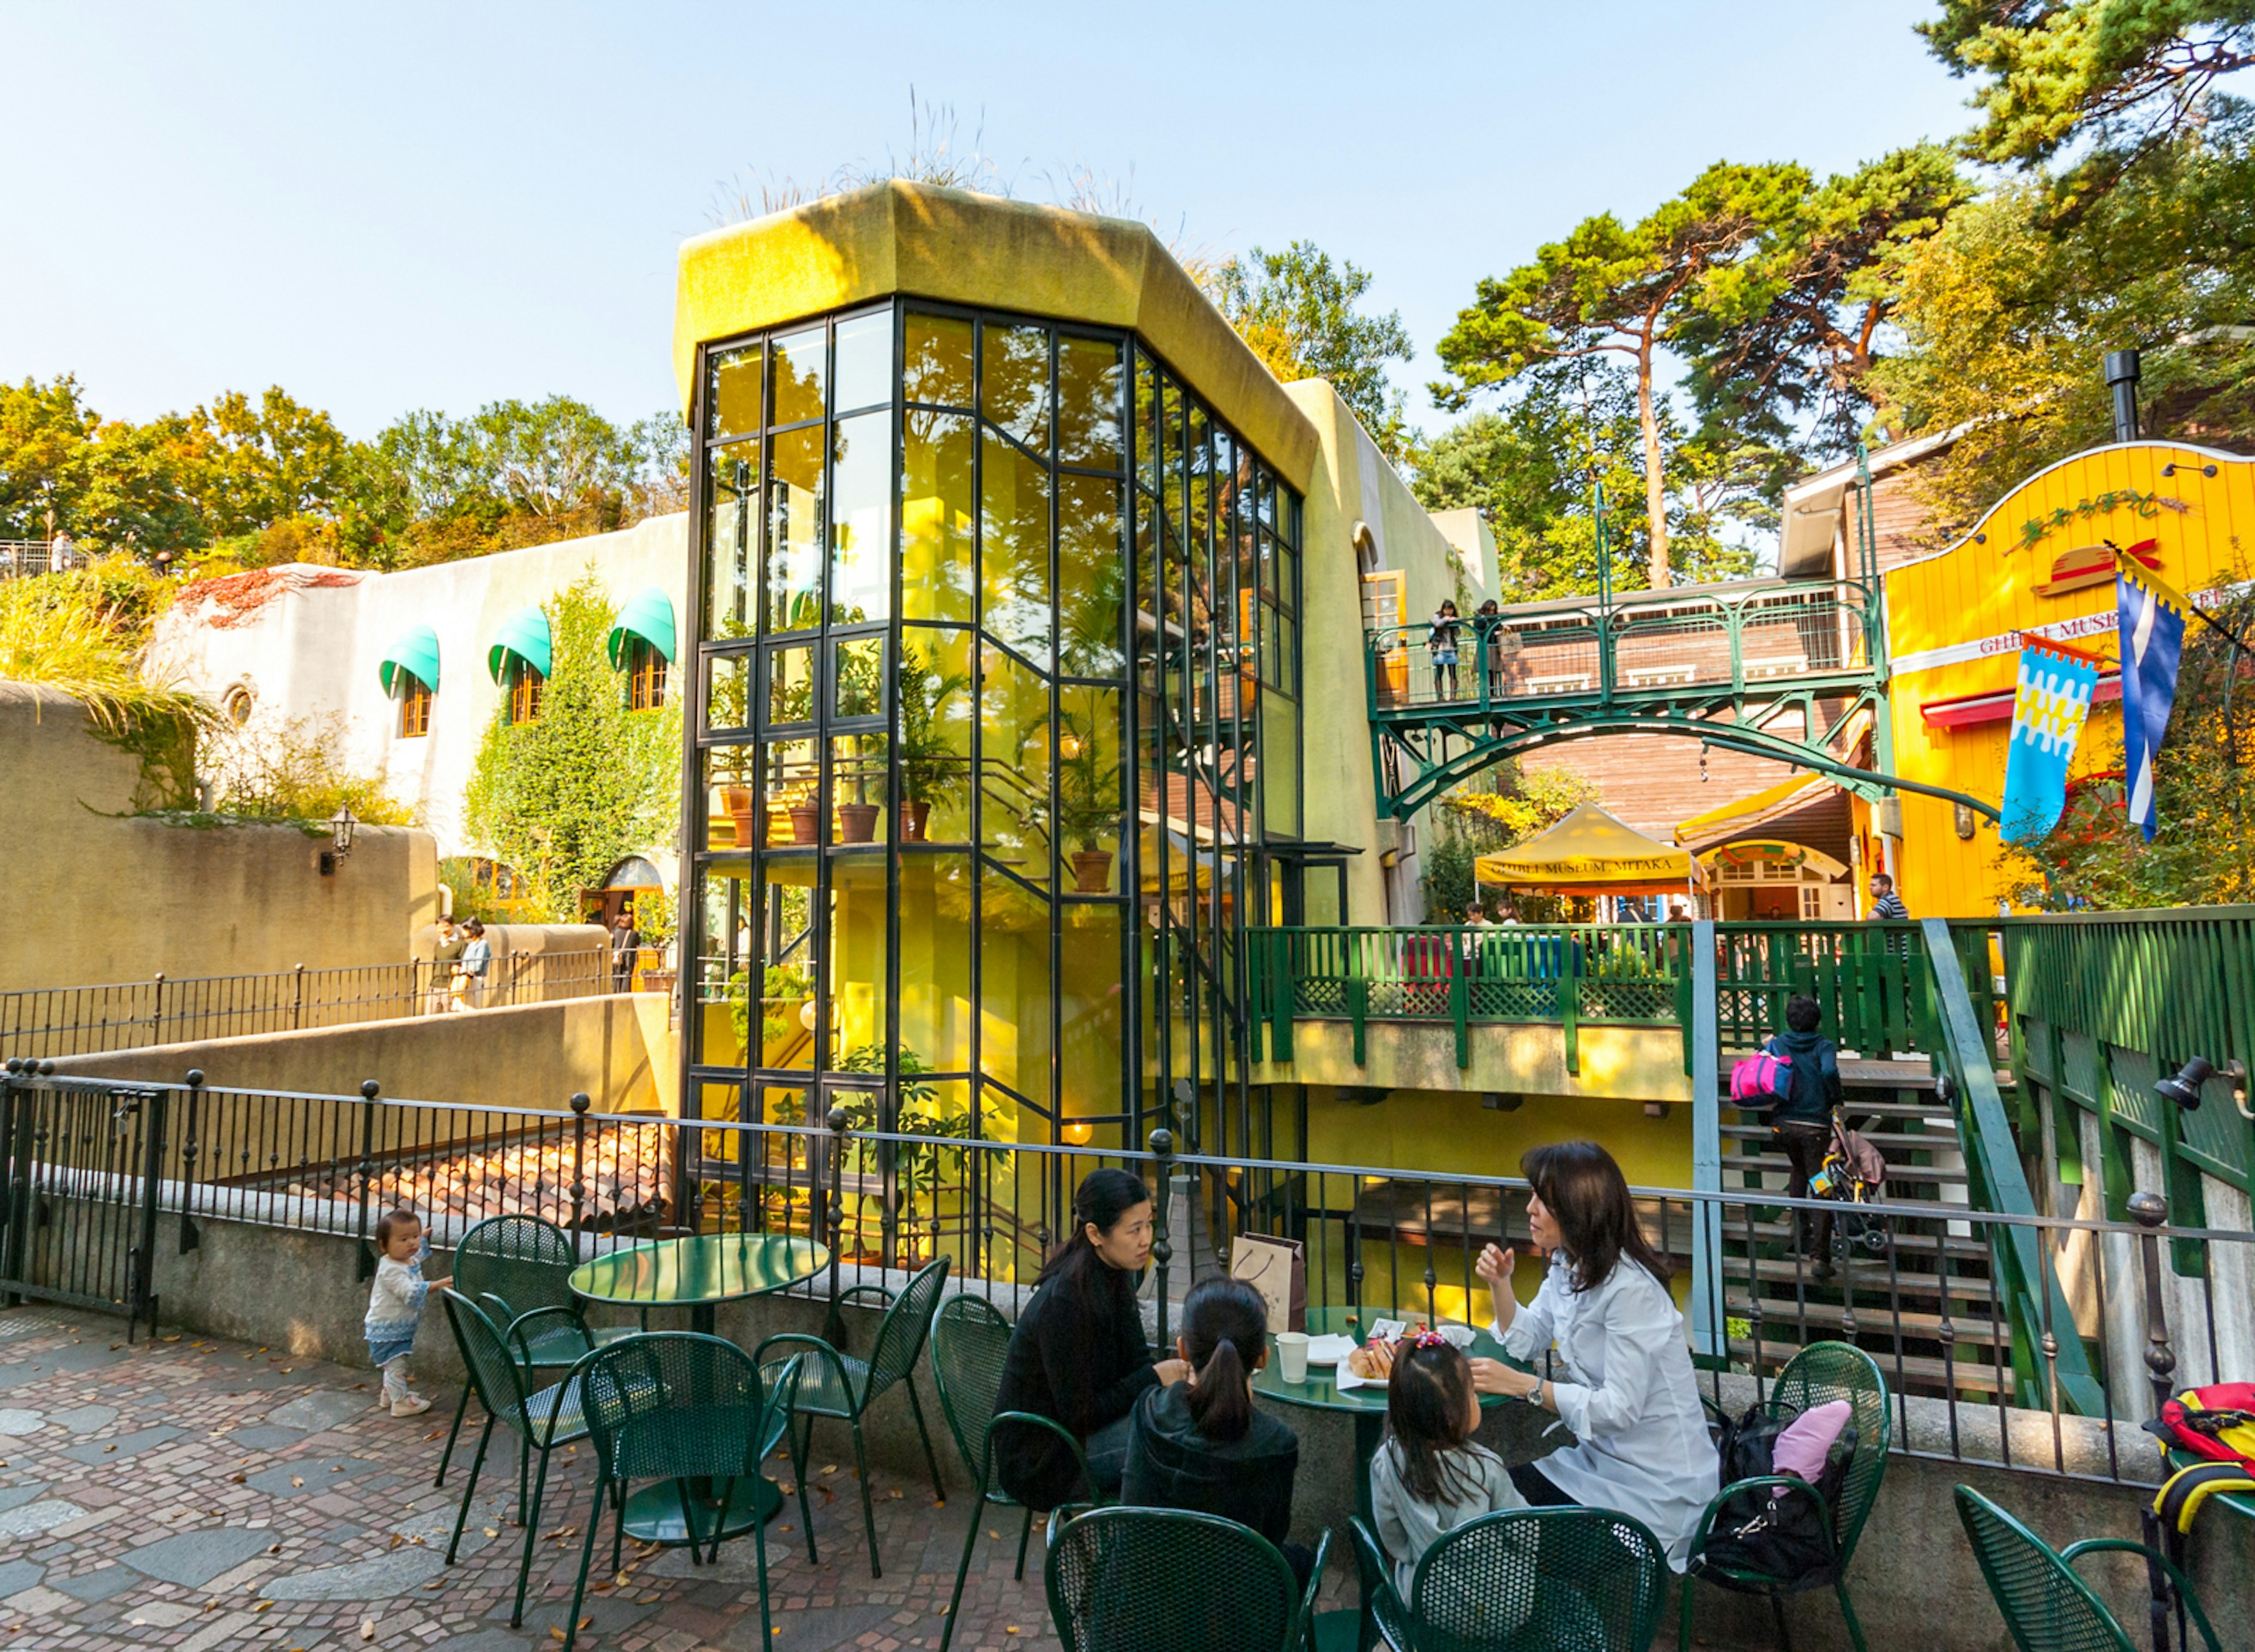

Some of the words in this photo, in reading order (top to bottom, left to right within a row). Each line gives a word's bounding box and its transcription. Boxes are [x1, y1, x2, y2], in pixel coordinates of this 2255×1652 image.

[1980, 627, 2048, 654] GHII
[2060, 613, 2119, 637] MUSE
[1615, 859, 1672, 871] MITAKA
